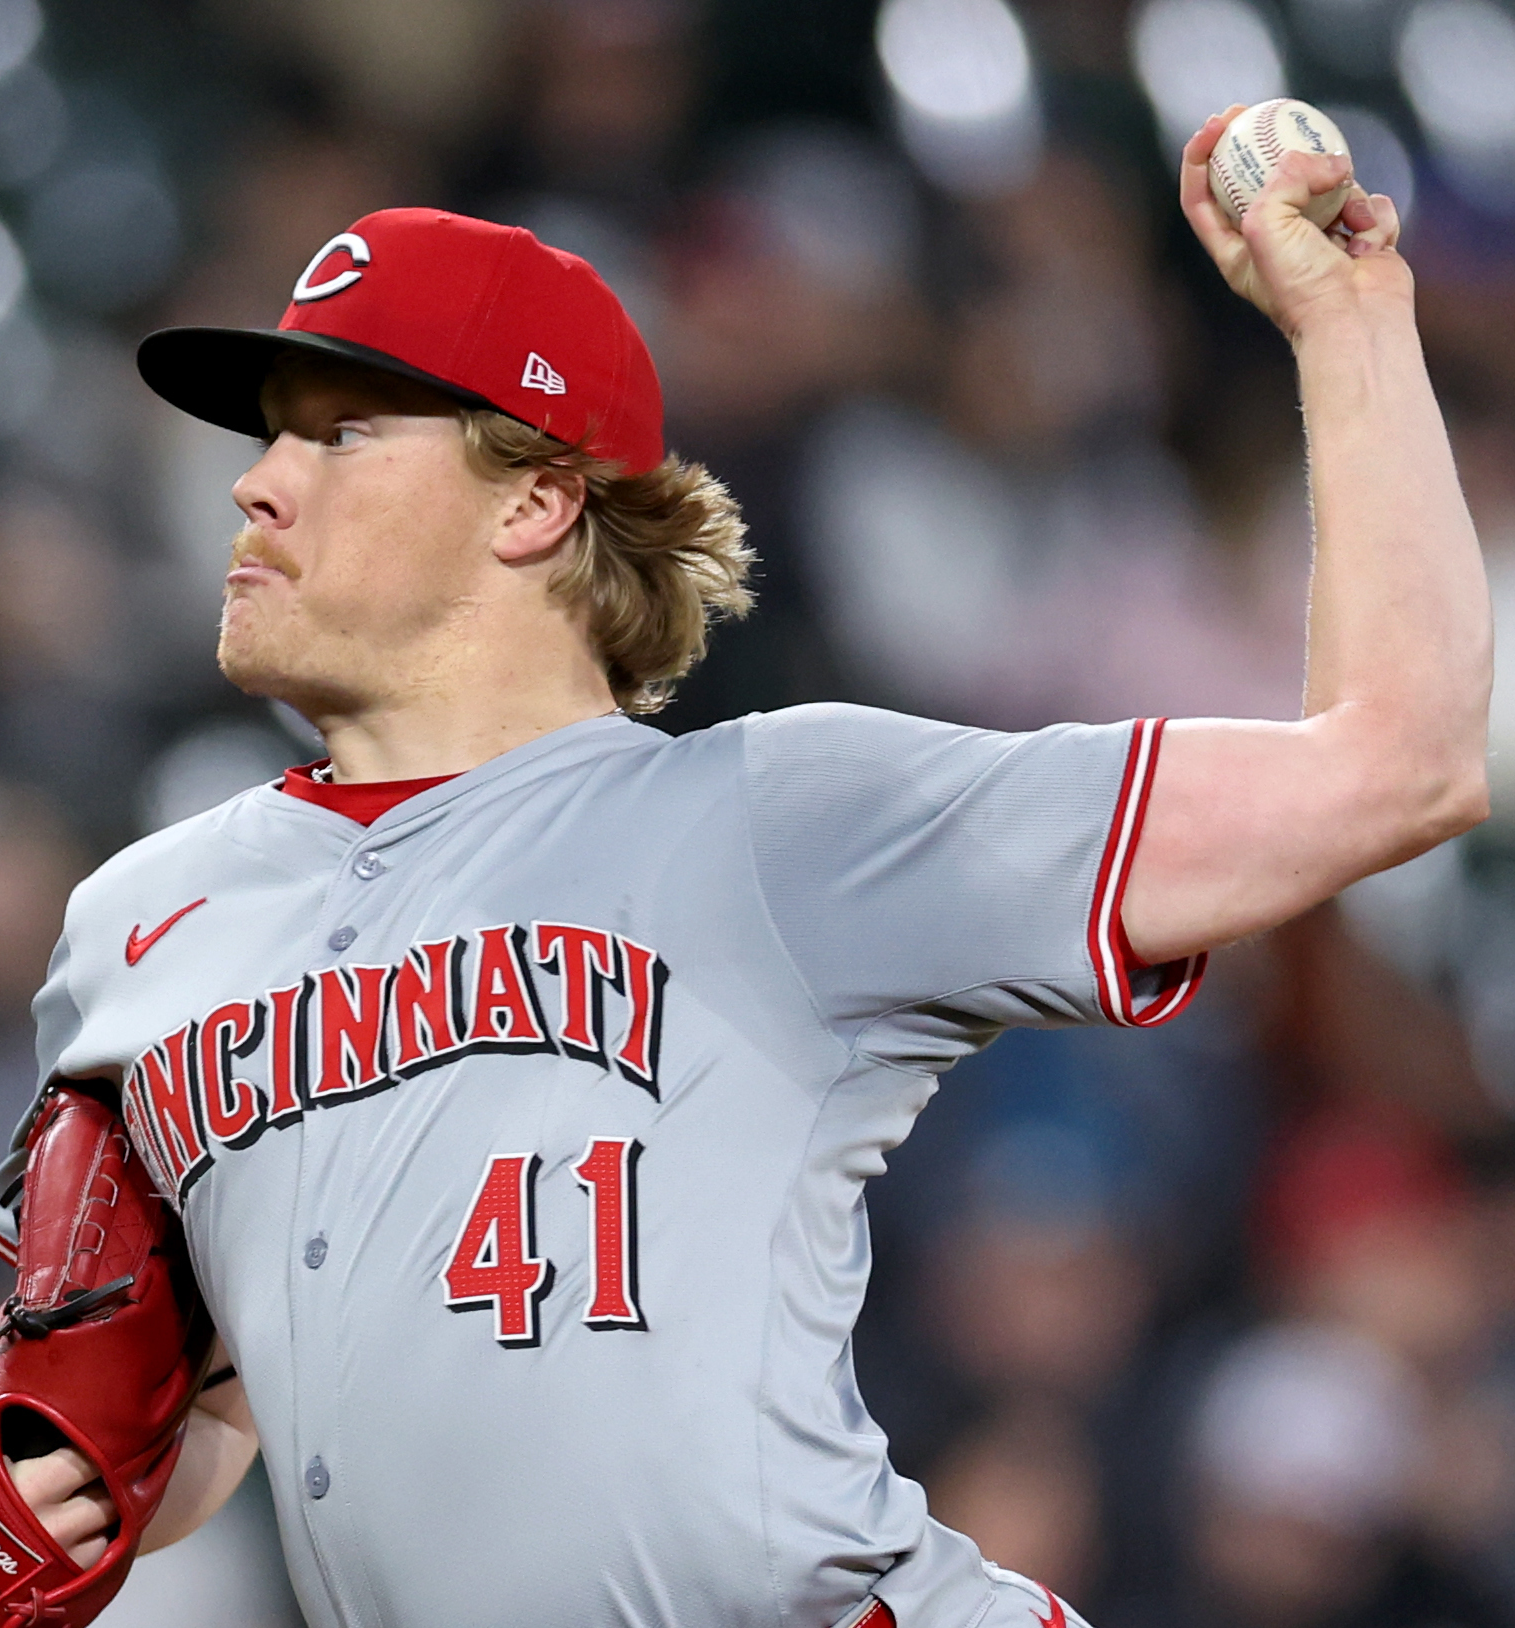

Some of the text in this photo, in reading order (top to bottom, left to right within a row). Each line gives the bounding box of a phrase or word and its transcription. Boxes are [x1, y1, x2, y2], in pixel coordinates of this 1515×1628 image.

[292, 232, 370, 306] C
[122, 920, 669, 1212] INCINNATI
[441, 1136, 648, 1349] 41
